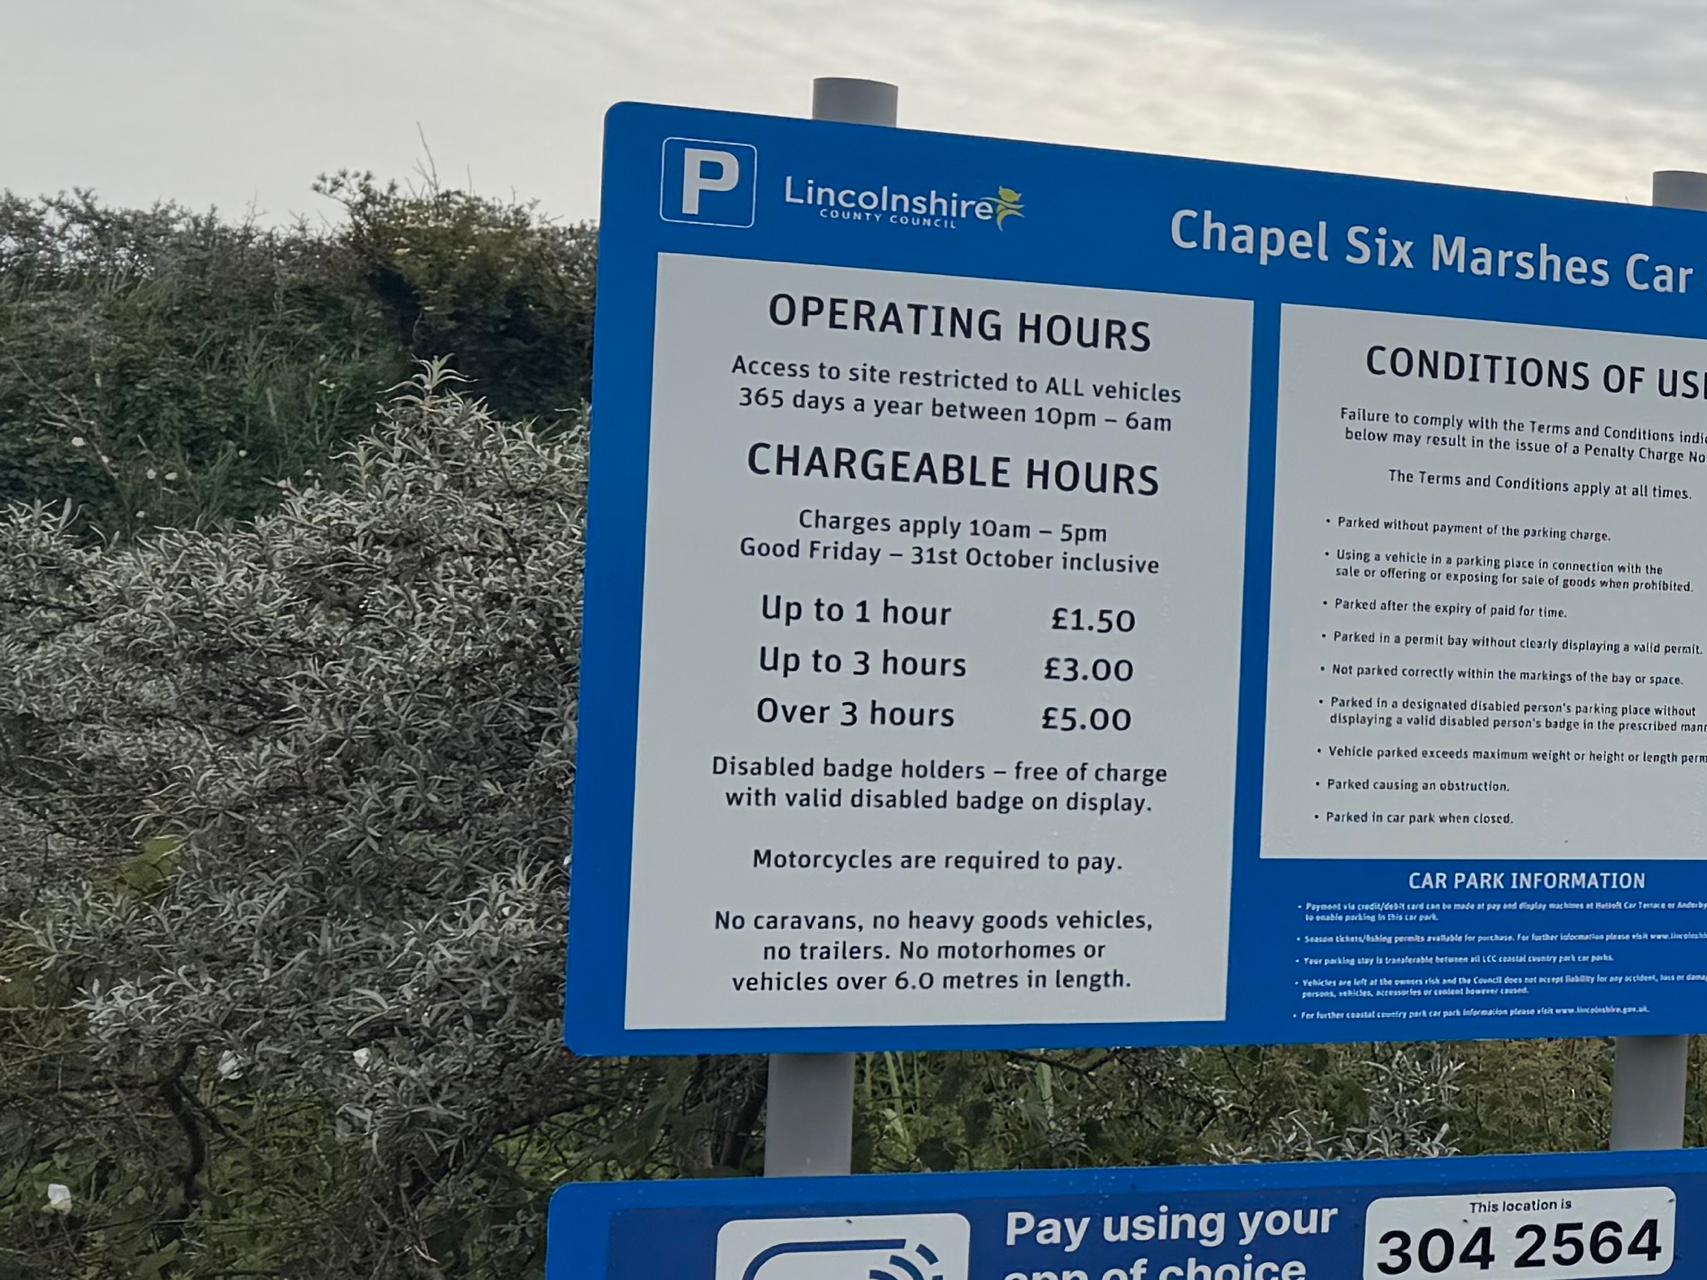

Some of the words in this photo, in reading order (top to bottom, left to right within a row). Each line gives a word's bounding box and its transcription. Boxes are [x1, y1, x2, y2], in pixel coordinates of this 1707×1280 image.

[681, 148, 740, 215] P
[784, 175, 994, 222] Lincolnshire
[819, 208, 883, 223] COUNTY
[889, 213, 958, 229] COUNCIL
[1171, 208, 1329, 267] Chapel
[1345, 225, 1414, 270] Six
[1432, 233, 1610, 288] Marshes
[1625, 252, 1694, 295] Car
[769, 292, 1002, 343] OPERATING
[1018, 311, 1151, 353] HOURS
[731, 354, 810, 380] Access
[818, 361, 841, 381] to
[848, 361, 891, 385] site
[899, 368, 1008, 392] restricted
[1016, 374, 1038, 395] to
[1045, 375, 1085, 398] ALL
[1092, 380, 1182, 404] vehicles
[1366, 344, 1590, 392] CONDITIONS
[1603, 363, 1646, 395] OF
[739, 385, 784, 409] 365
[792, 388, 845, 415] days
[853, 397, 865, 413] a
[873, 398, 924, 419] year
[931, 396, 1026, 424] between
[1034, 406, 1096, 430] 10pm
[1125, 410, 1172, 432] 6am
[748, 441, 1011, 489] CHARGEABLE
[1026, 457, 1159, 497] HOURS
[799, 508, 891, 536] Charges
[898, 514, 962, 541] apply
[969, 518, 1031, 540] 10am
[1060, 522, 1107, 547] 5pm
[740, 536, 800, 559] Good
[809, 539, 882, 567] Friday
[911, 545, 958, 566] 31st
[965, 546, 1054, 570] October
[1061, 550, 1160, 575] inclusive
[762, 593, 803, 628] Up
[813, 597, 844, 623] to
[856, 598, 871, 624] 1
[882, 597, 952, 627] hour
[1051, 606, 1136, 634] £1.50
[759, 645, 801, 679] Up
[811, 648, 842, 674] to
[852, 650, 870, 677] 3
[882, 648, 966, 678] hours
[1044, 656, 1134, 683] £3.00
[757, 697, 831, 725] Over
[840, 700, 858, 727] 3
[870, 698, 955, 728] hours
[1041, 705, 1132, 733] £5.00
[712, 754, 814, 778] Disabled
[823, 756, 893, 783] badge
[901, 757, 985, 781] holders
[1014, 759, 1058, 782] free
[1066, 761, 1089, 782] of
[1094, 762, 1168, 788] charge
[1327, 778, 1370, 791] Parked
[1372, 778, 1419, 793] causing
[1421, 781, 1436, 791] an
[1439, 779, 1510, 793] obstruction.
[725, 785, 777, 808] with
[785, 786, 842, 809] valid
[850, 787, 948, 810] disabled
[956, 789, 1024, 815] badge
[1031, 795, 1058, 811] on
[1066, 790, 1152, 817] display.
[753, 848, 893, 874] Motorcycles
[900, 854, 936, 870] are
[944, 849, 1040, 874] required
[1048, 852, 1069, 871] to
[1077, 855, 1123, 875] pay.
[1408, 871, 1447, 890] CAR
[1453, 871, 1505, 890] PARK
[1511, 871, 1645, 890] INFORMATION
[715, 909, 745, 931] No
[753, 914, 864, 933] caravans,
[873, 914, 900, 930] no
[908, 909, 975, 934] heavy
[981, 908, 1049, 934] goods
[1056, 909, 1153, 933] vehicles,
[763, 944, 791, 961] no
[799, 939, 890, 961] trailers.
[899, 940, 929, 961] No
[937, 938, 1076, 961] motorhomes
[1083, 943, 1106, 959] or
[732, 970, 828, 993] vehicles
[836, 975, 888, 991] over
[894, 970, 934, 991] 6.0
[942, 971, 1019, 990] metres
[1027, 969, 1047, 989] in
[1055, 968, 1131, 993] length.
[1469, 1200, 1499, 1214] This
[1502, 1198, 1558, 1213] location
[1560, 1197, 1572, 1211] is
[1006, 1210, 1091, 1253] Pay
[1103, 1204, 1226, 1248] using
[1238, 1207, 1339, 1246] your
[1376, 1220, 1496, 1276] 304
[1513, 1218, 1662, 1269] 2564
